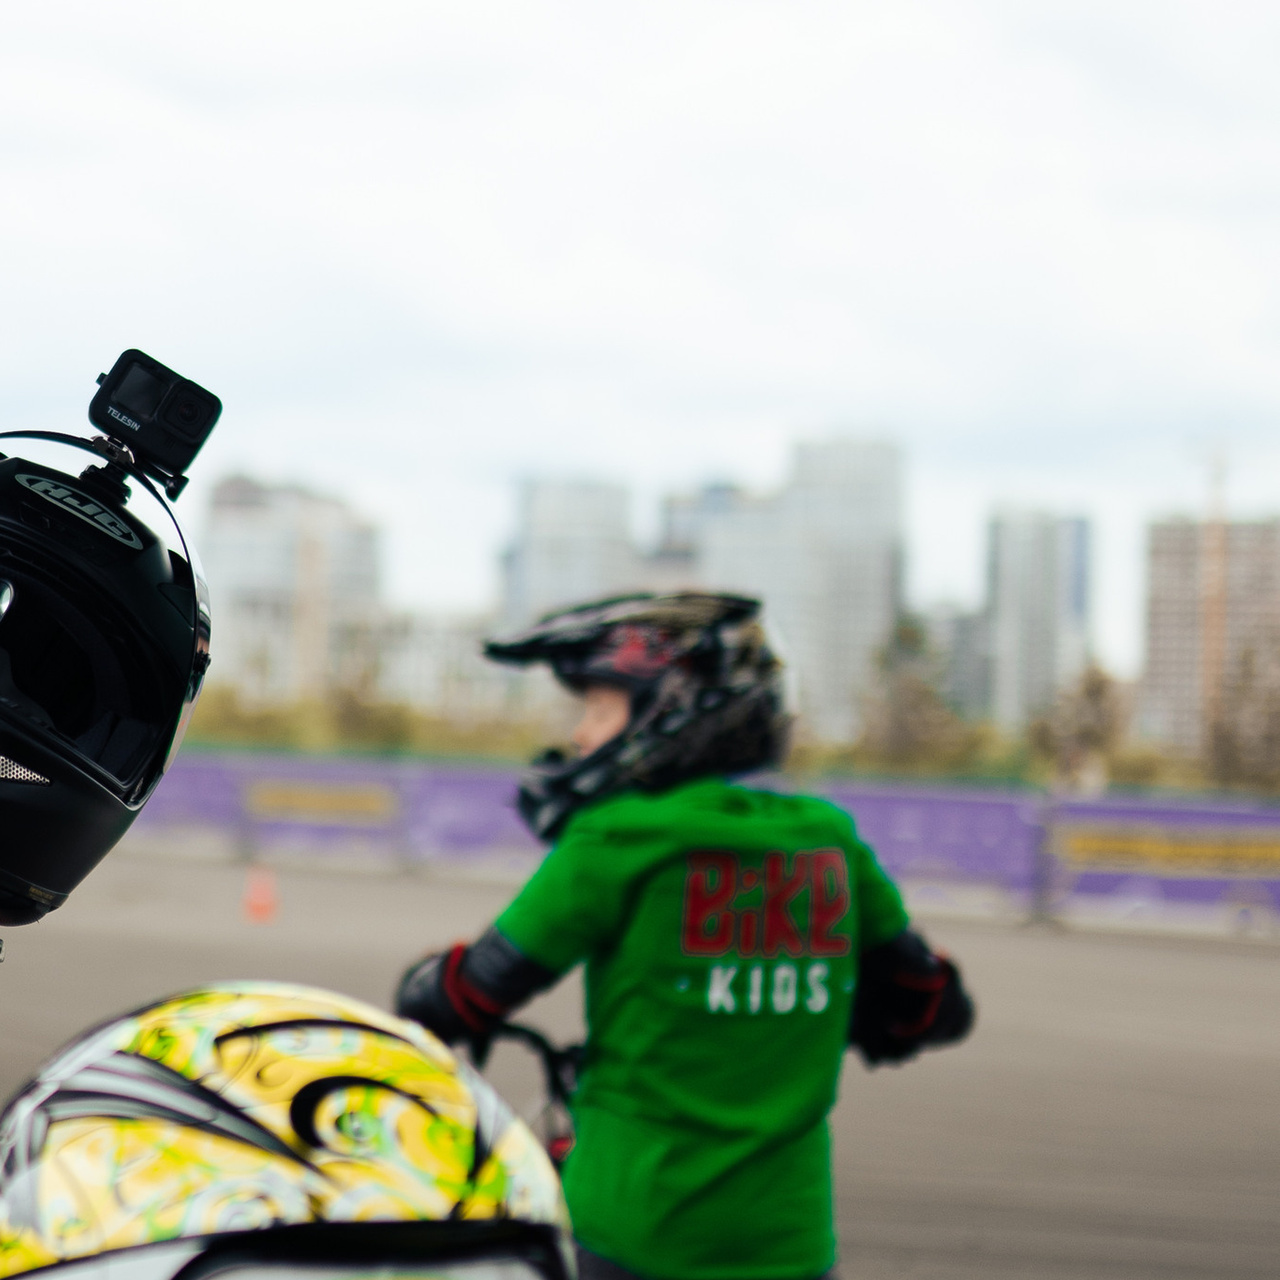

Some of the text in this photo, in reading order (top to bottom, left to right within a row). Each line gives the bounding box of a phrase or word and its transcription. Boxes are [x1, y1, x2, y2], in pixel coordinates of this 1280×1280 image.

[107, 406, 141, 432] TELESIN
[31, 481, 131, 536] HJC
[707, 964, 829, 1014] KIDS
